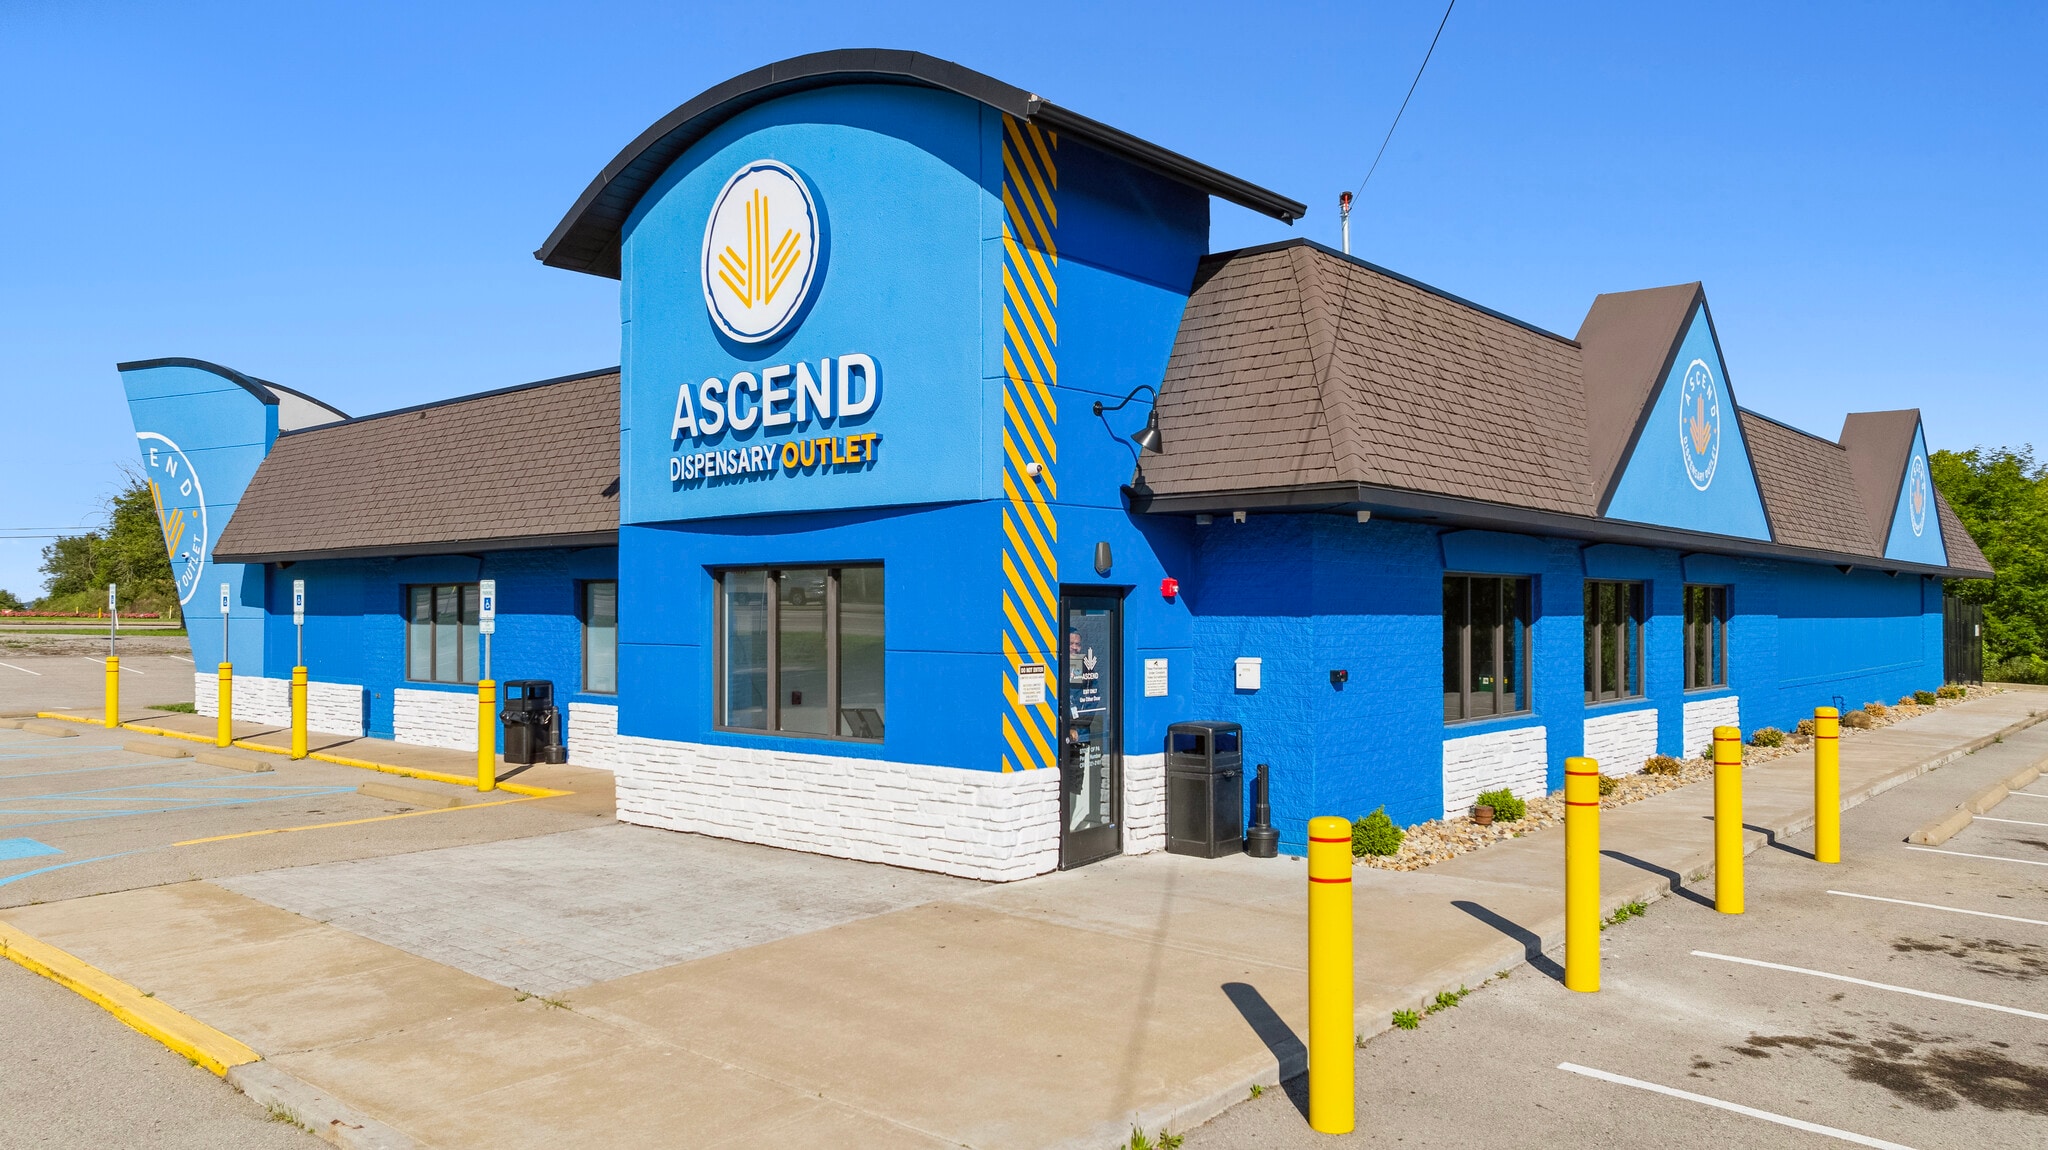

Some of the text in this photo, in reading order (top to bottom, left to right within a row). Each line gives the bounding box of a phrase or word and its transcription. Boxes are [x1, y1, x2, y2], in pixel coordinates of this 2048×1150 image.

[671, 353, 877, 440] ASCEND
[1685, 371, 1716, 417] ASCEND
[670, 432, 877, 482] DISPENSARY OUTLET
[182, 533, 201, 587] OUTLET
